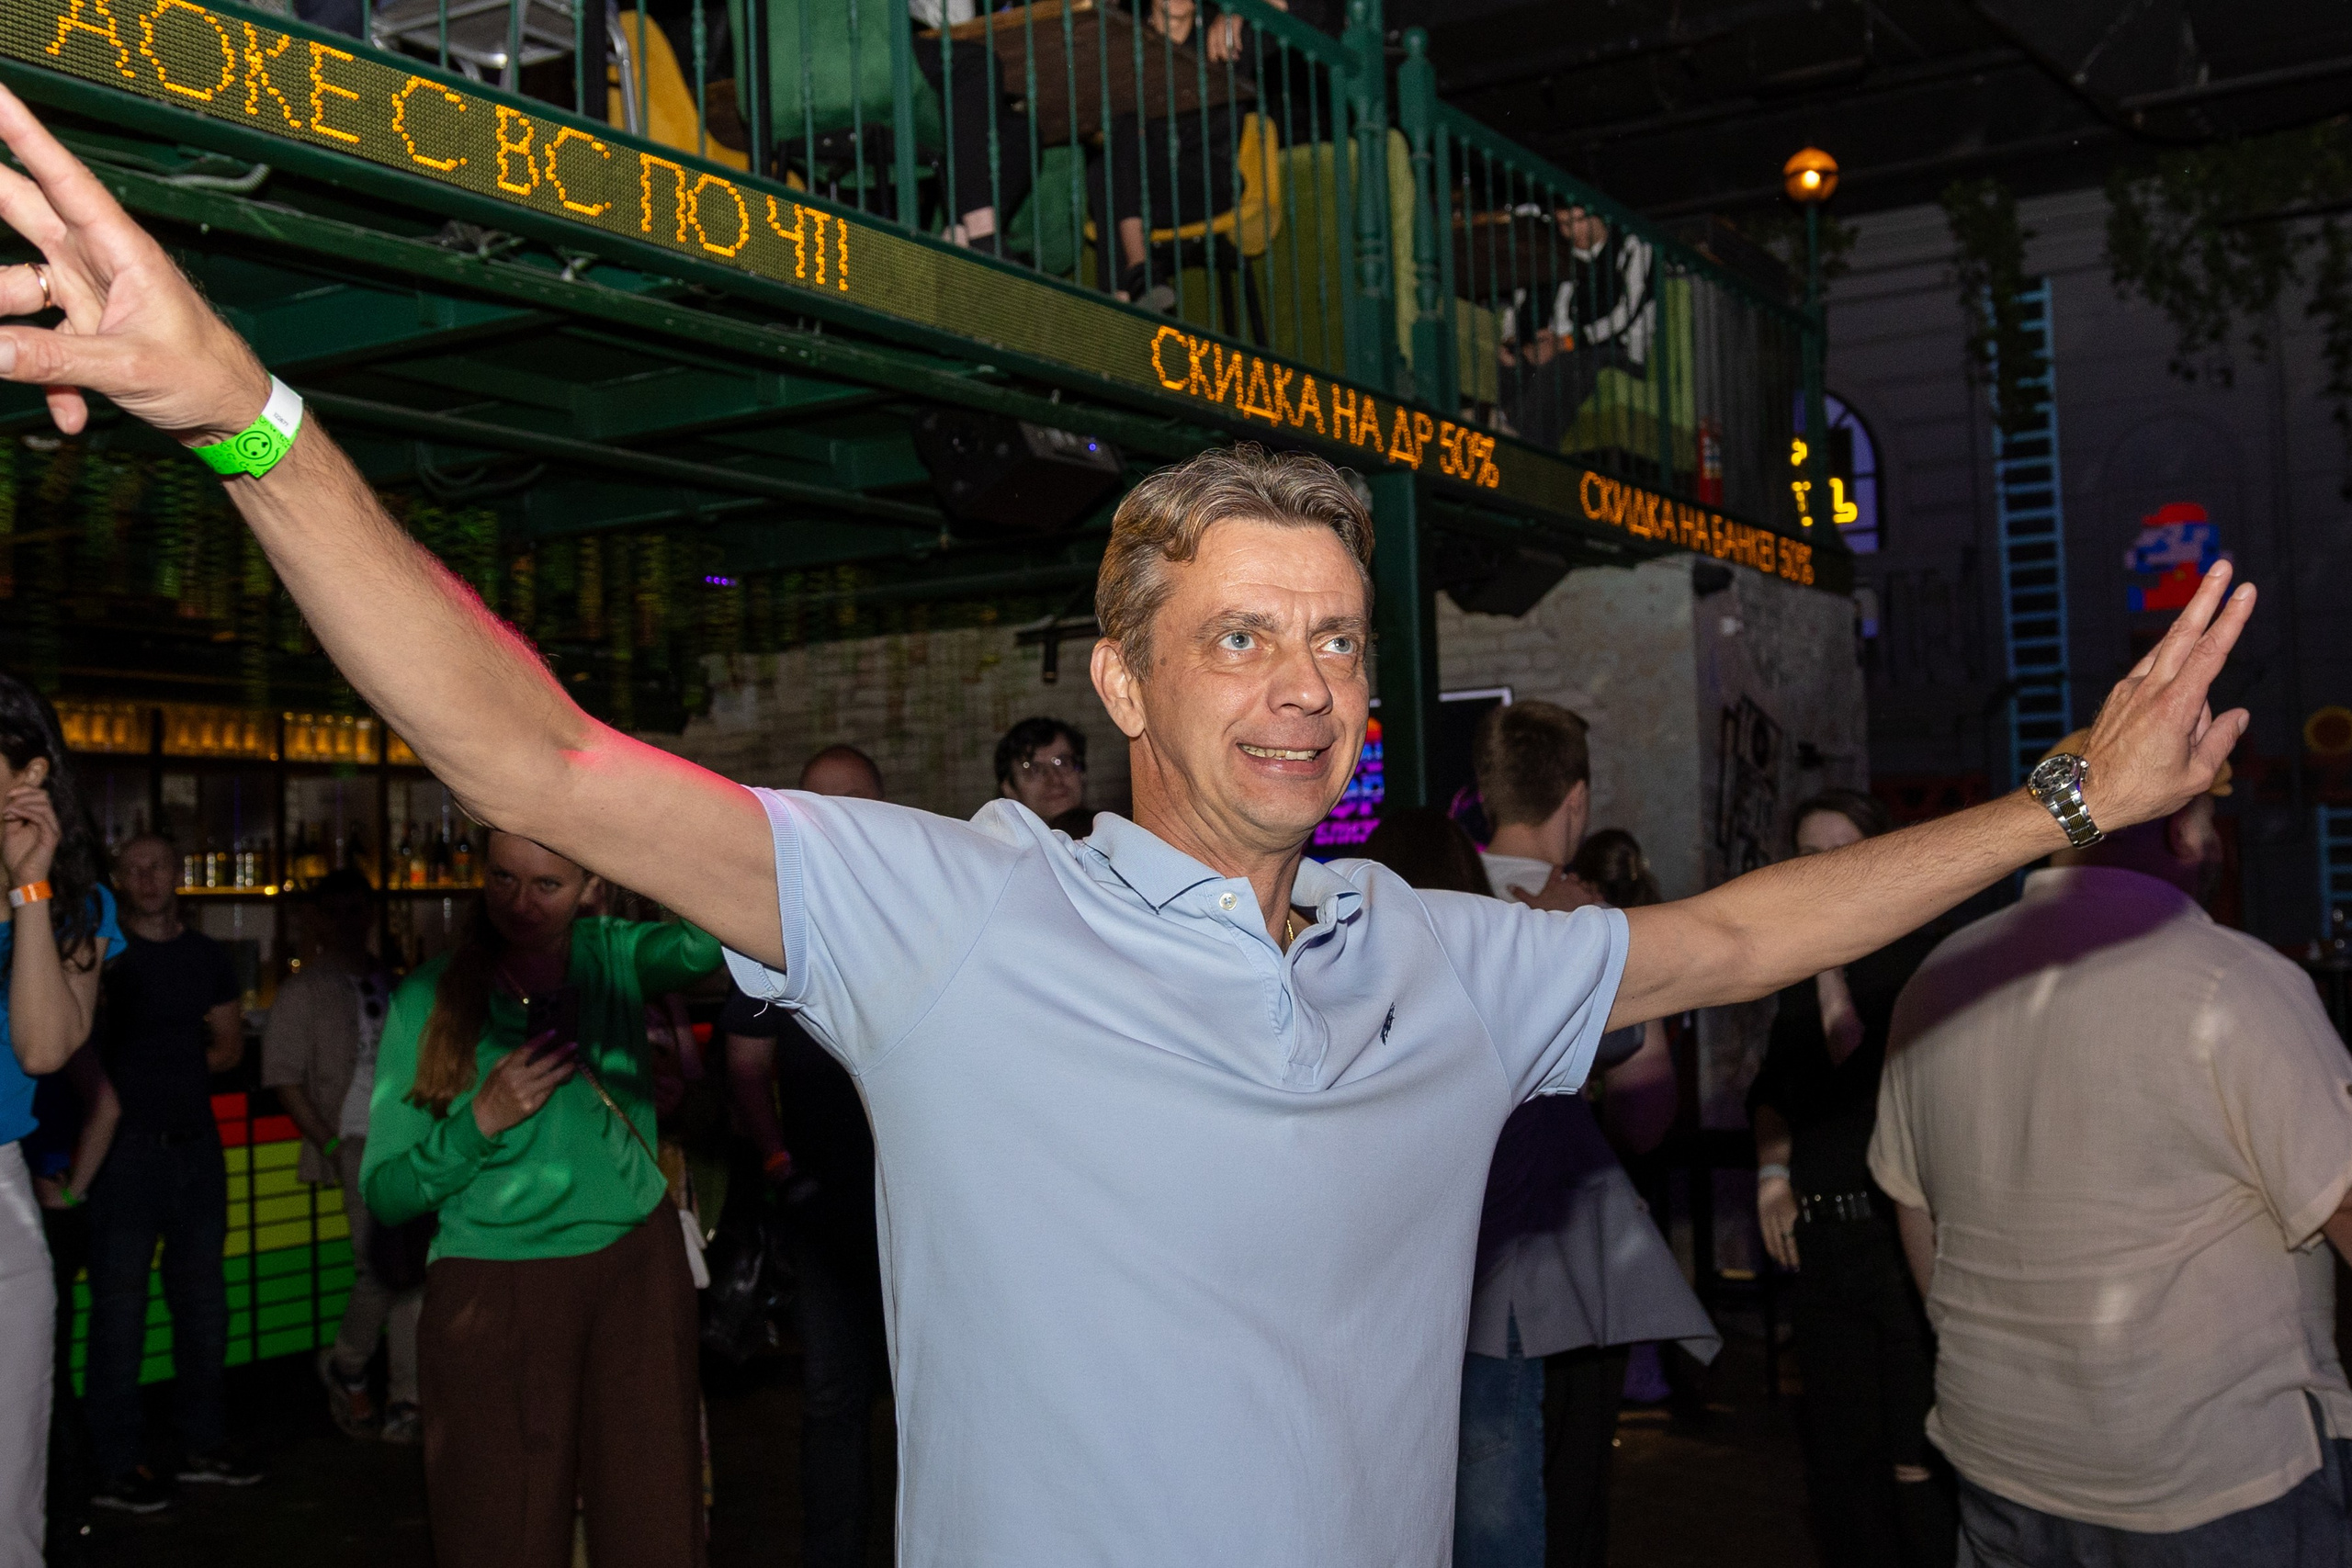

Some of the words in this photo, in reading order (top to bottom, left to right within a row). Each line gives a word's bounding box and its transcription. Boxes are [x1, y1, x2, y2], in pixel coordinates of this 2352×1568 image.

[45, 0, 360, 144] АОКЕ
[391, 75, 467, 172] С
[495, 104, 612, 218] ВС
[766, 194, 849, 292] ЧТ!
[1151, 325, 1326, 434] СКИДКА
[1331, 383, 1385, 453] НА
[1388, 405, 1434, 470] ДР
[1440, 421, 1500, 489] 50%
[1579, 471, 1679, 545] СКИДКА
[1679, 502, 1712, 554] НА
